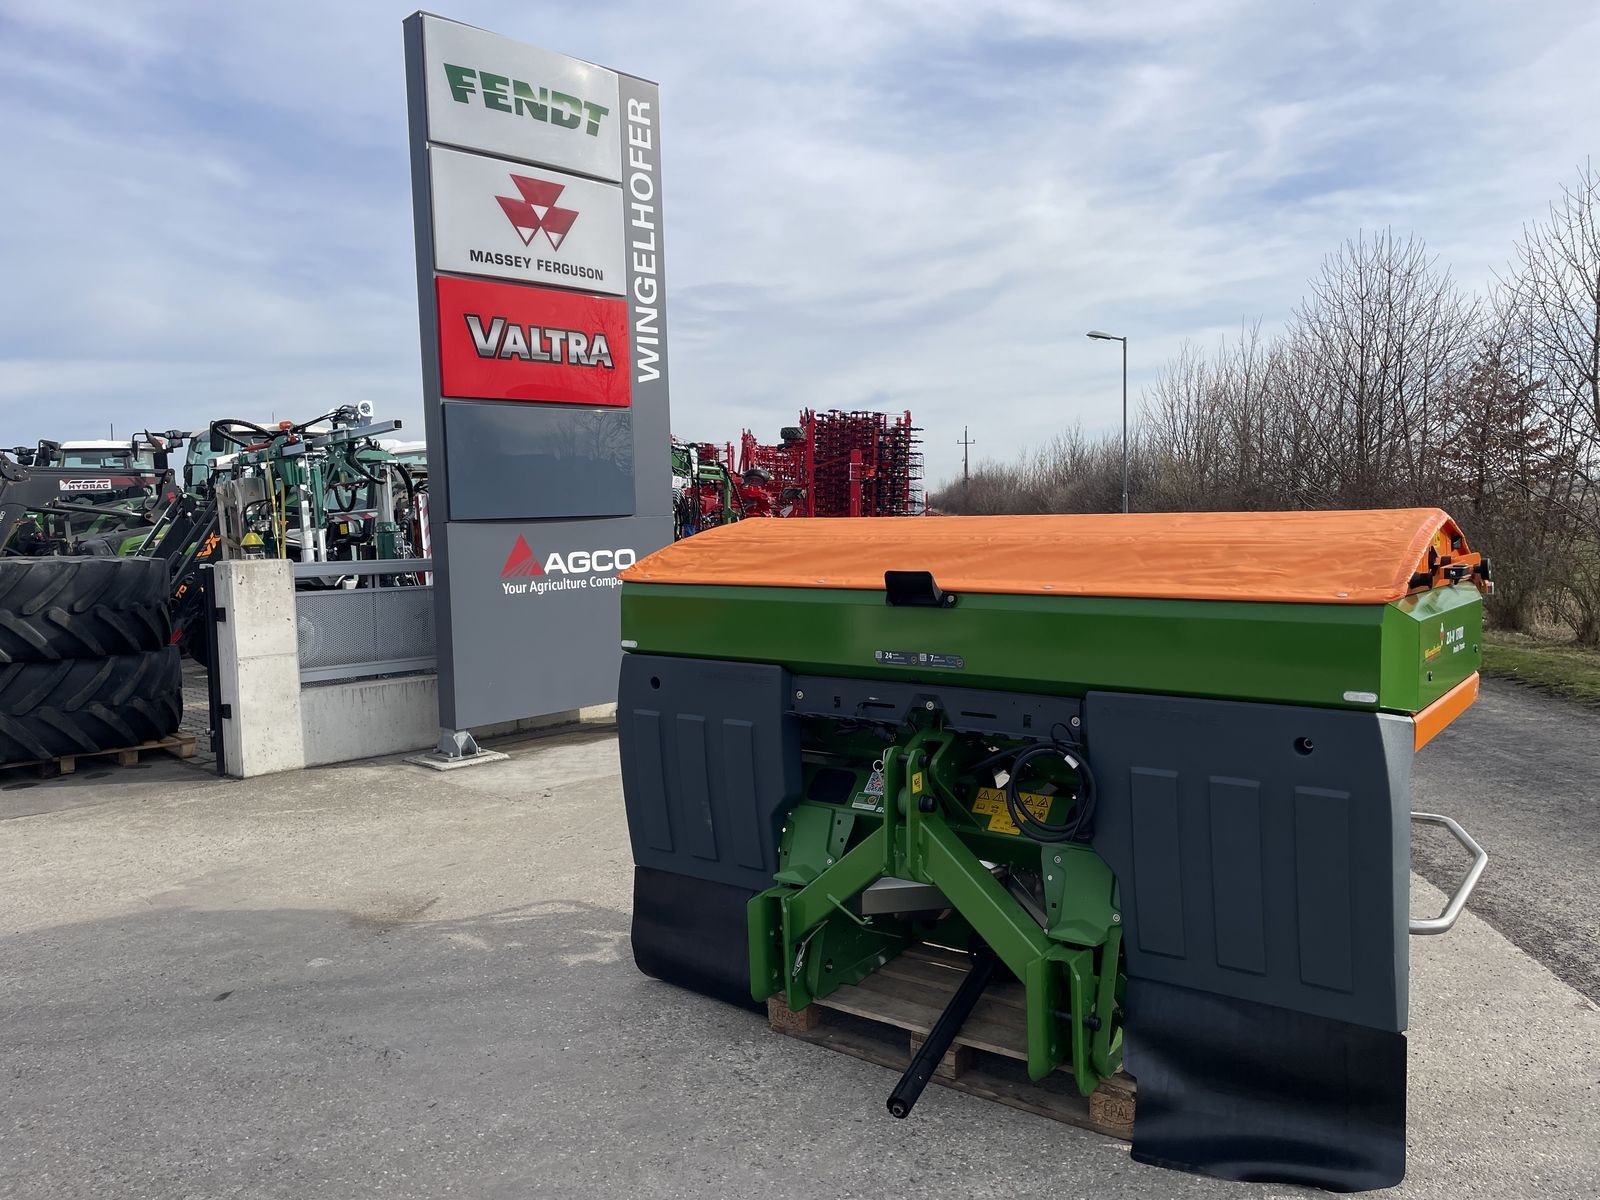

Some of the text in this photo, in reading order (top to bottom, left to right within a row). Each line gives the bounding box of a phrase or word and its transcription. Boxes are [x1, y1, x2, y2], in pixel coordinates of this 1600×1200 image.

[443, 63, 610, 137] FENDT
[626, 97, 662, 384] WINGELHOFER
[469, 249, 604, 281] MASSEY FERGUSON
[464, 313, 615, 370] VALTRA
[543, 548, 637, 575] AGCO
[502, 576, 623, 595] Your Agriculture Compa
[884, 652, 893, 660] 24
